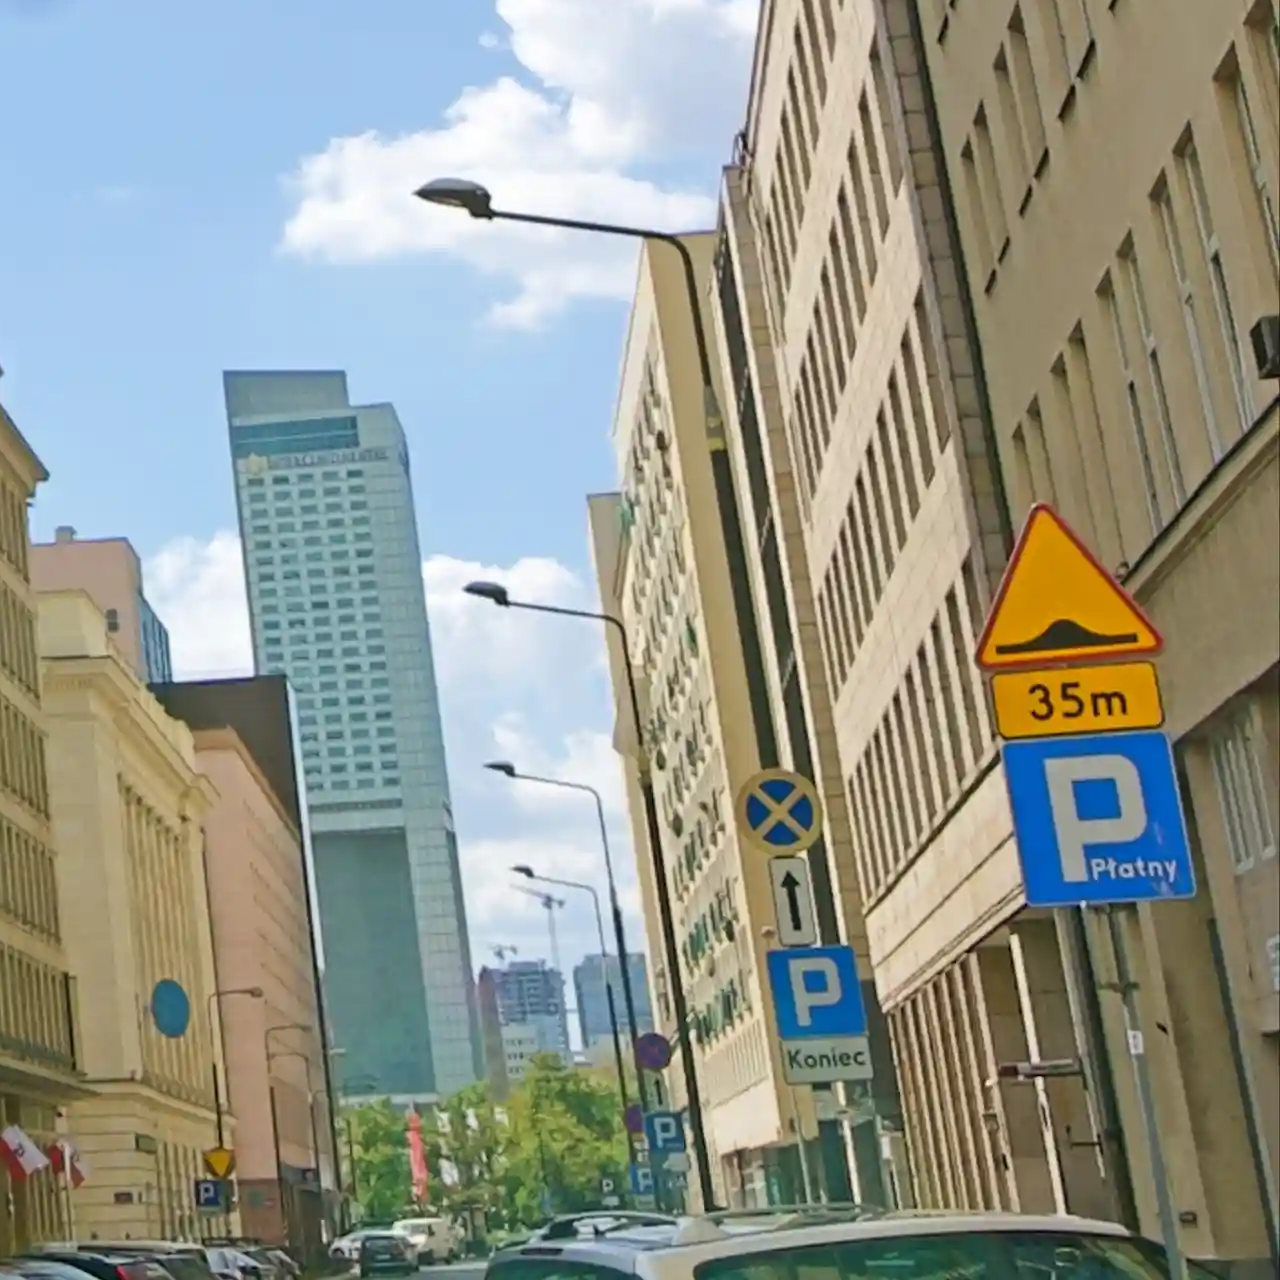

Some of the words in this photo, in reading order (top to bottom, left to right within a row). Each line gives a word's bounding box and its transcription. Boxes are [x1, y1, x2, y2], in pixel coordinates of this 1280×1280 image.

[1028, 681, 1128, 721] 35m
[1044, 753, 1148, 882] P
[1091, 856, 1177, 883] Płatny
[788, 957, 842, 1027] P
[787, 1046, 867, 1070] Koniec
[653, 1117, 676, 1148] P
[199, 1183, 214, 1204] P
[602, 1178, 614, 1193] P
